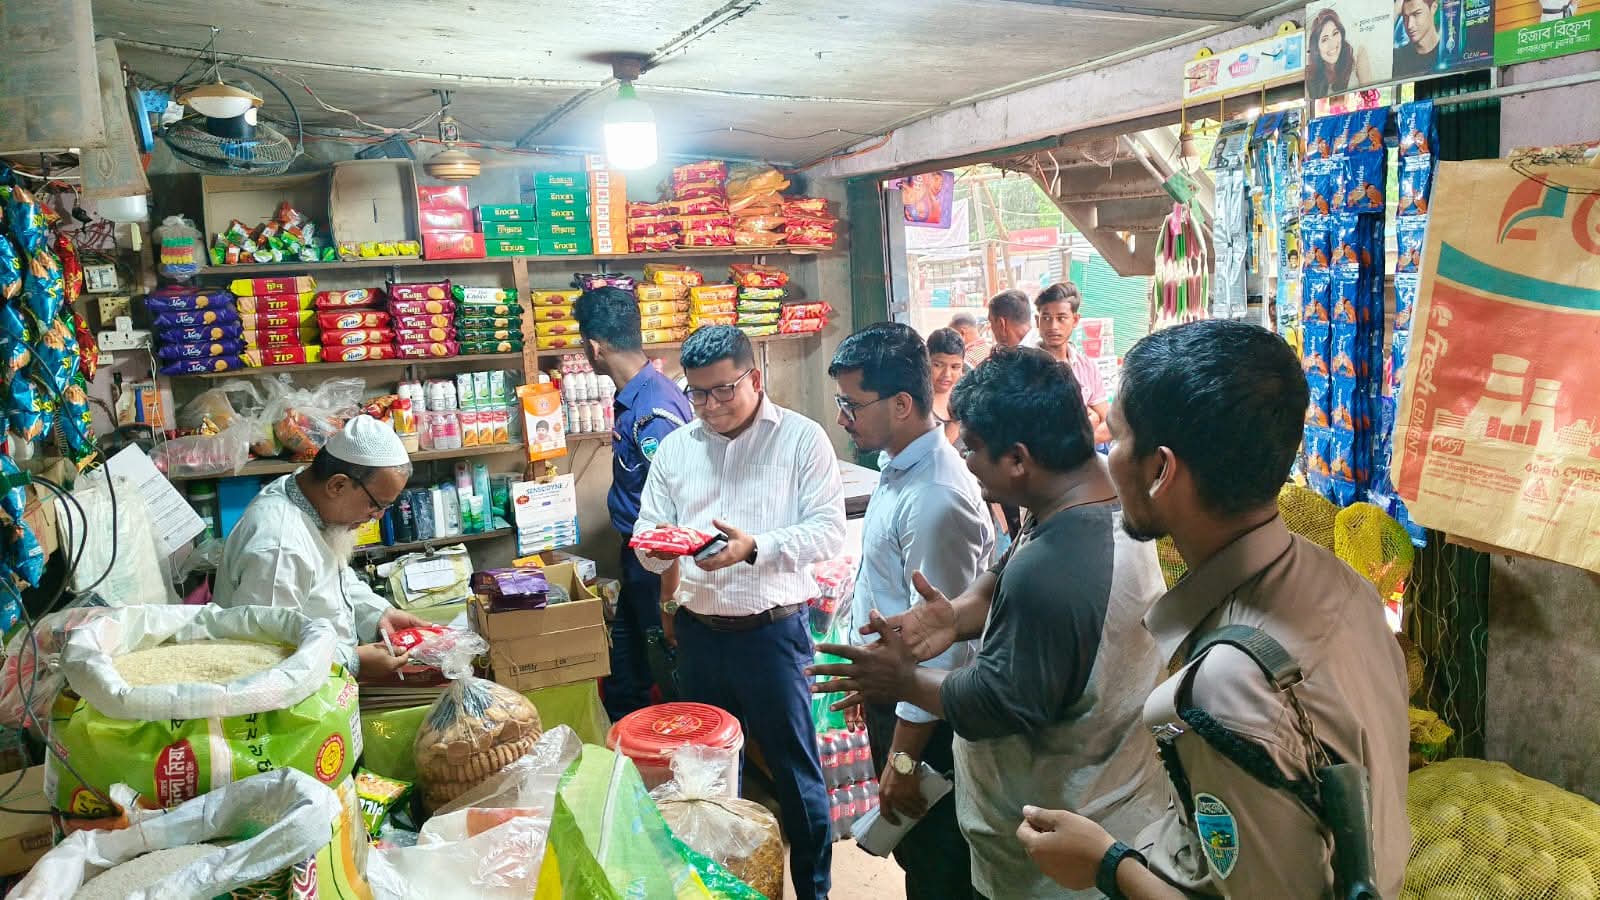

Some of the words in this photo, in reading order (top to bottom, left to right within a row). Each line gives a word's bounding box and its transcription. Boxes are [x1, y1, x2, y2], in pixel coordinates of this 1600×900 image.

[1518, 27, 1552, 45] হিজাব
[500, 244, 525, 252] LEXUS
[269, 301, 288, 309] TIP
[269, 318, 288, 326] TIP
[269, 334, 288, 342] TIP
[273, 354, 294, 362] TIP
[1406, 397, 1427, 461] CEMENT
